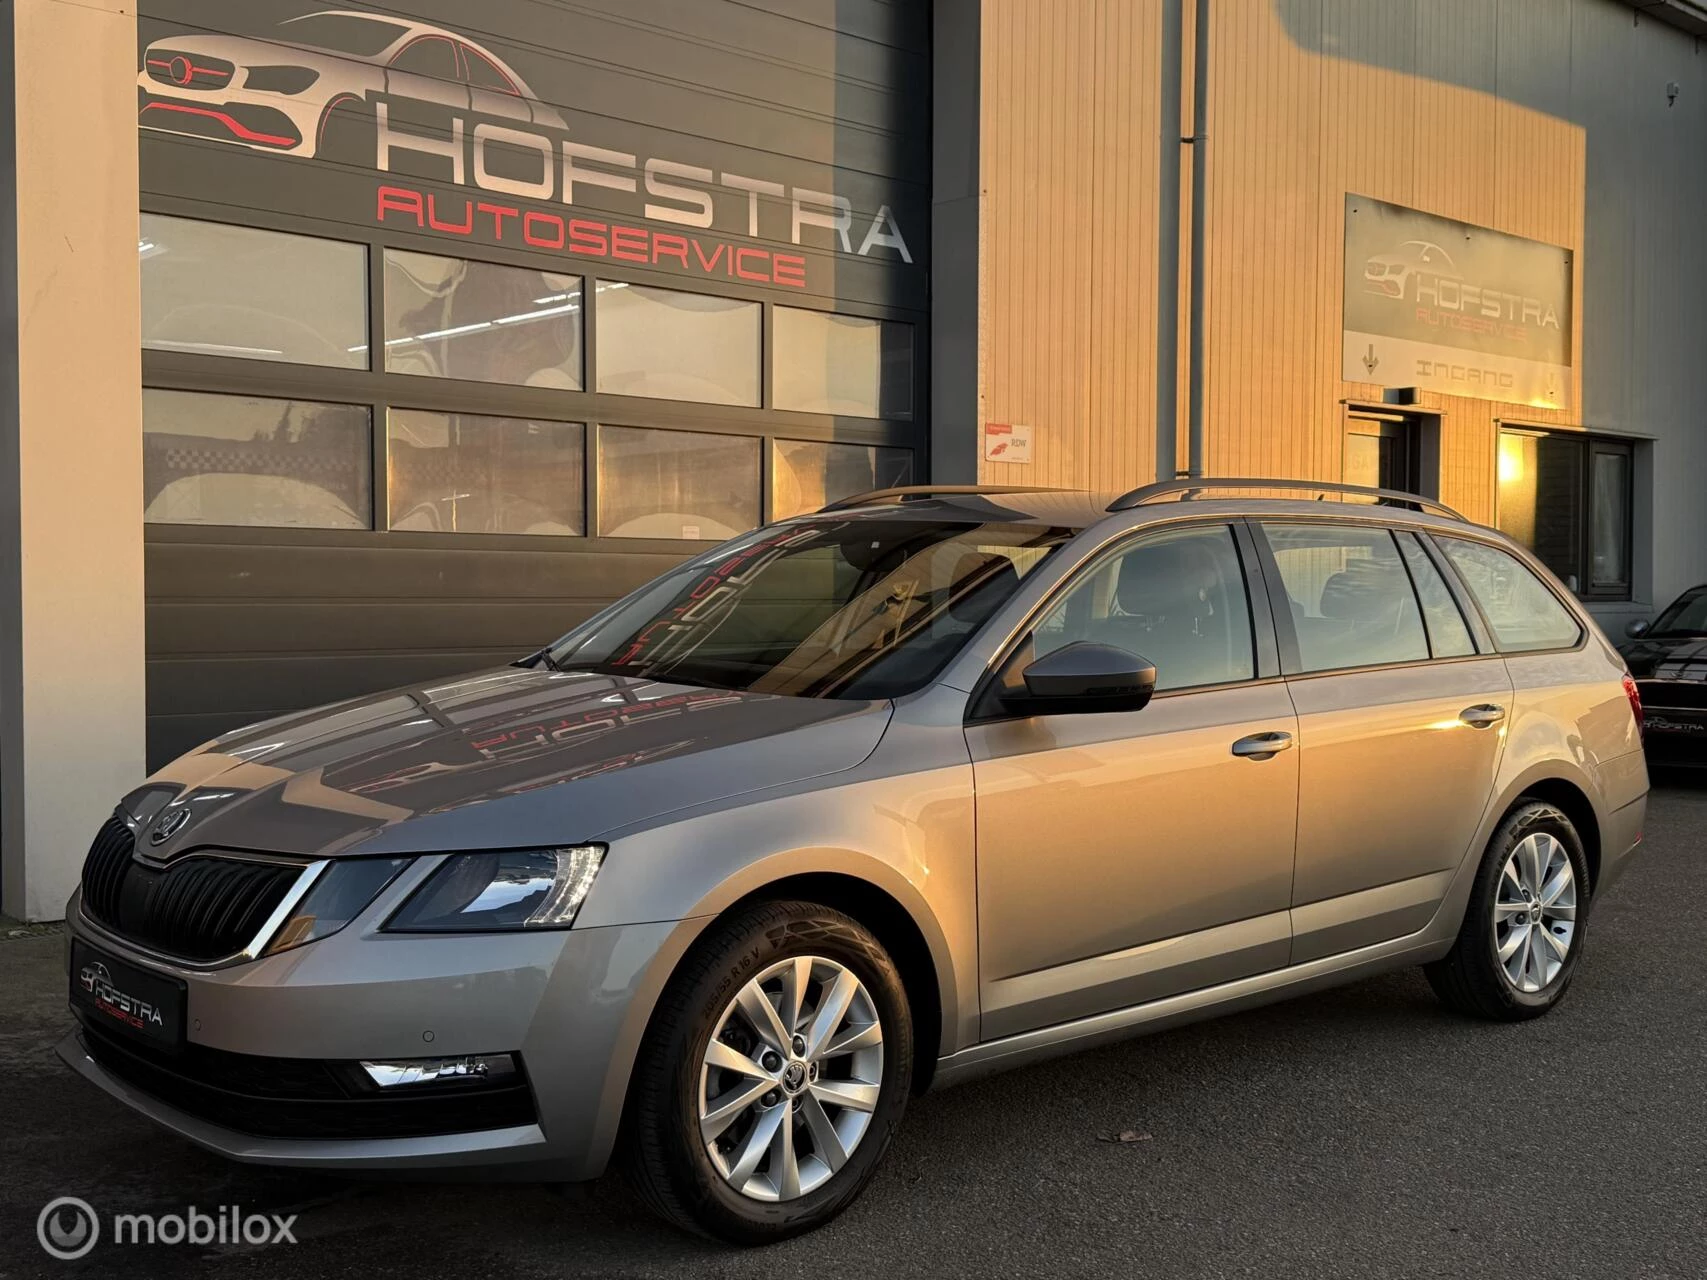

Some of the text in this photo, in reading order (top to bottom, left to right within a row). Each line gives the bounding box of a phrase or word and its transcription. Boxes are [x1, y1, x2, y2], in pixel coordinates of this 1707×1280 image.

[376, 101, 913, 264] HOFSTRA
[376, 185, 807, 288] AUTOSERVICE
[1416, 274, 1560, 329] HOFSTRA
[1416, 359, 1514, 388] INGANG
[95, 979, 163, 1026] HOFSTRA
